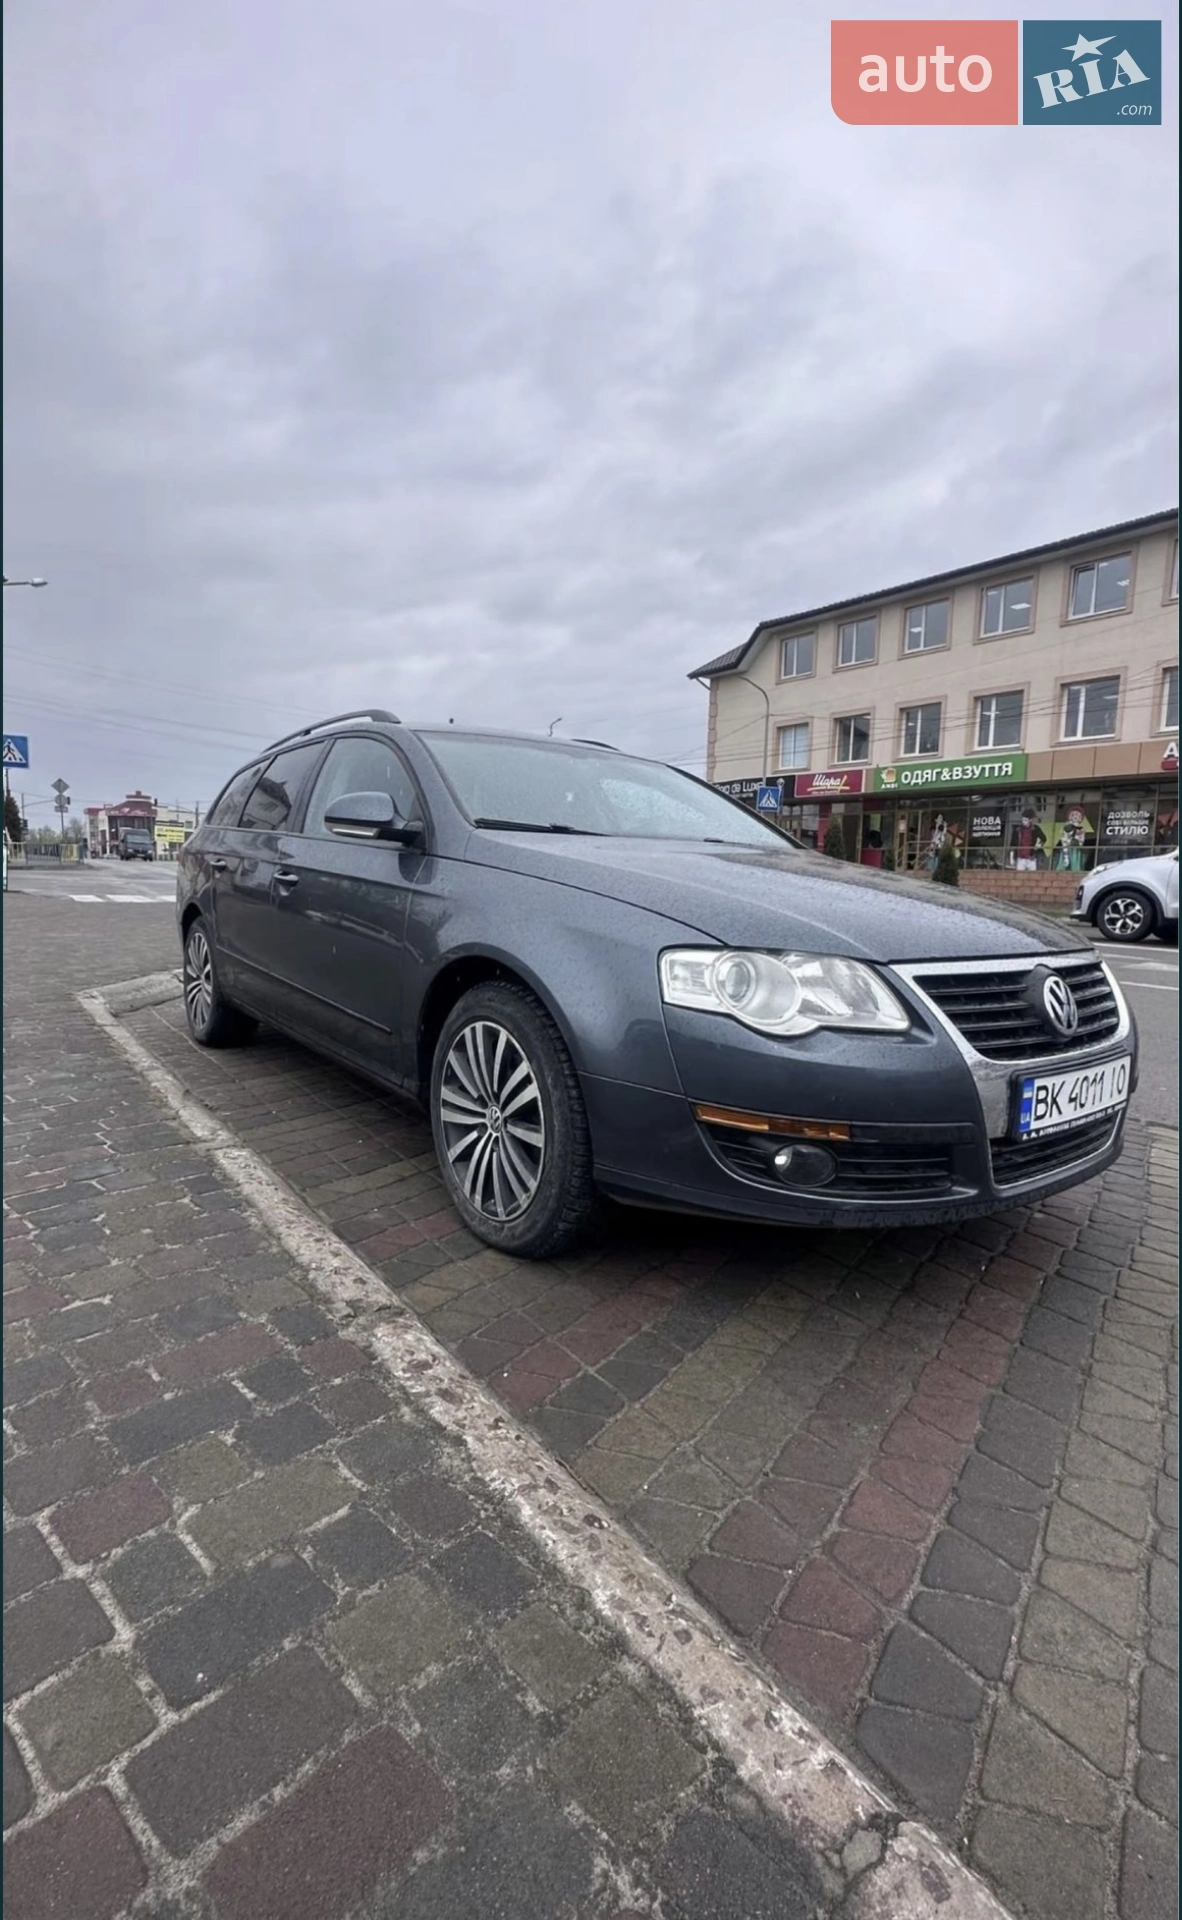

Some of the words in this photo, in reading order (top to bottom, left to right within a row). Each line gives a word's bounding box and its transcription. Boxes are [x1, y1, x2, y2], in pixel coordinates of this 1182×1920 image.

[901, 762, 1013, 786] ОДЯГ&ВЗУТТЯ
[973, 816, 1001, 826] НОВА
[1106, 826, 1149, 836] СТИЛЮ
[1034, 1080, 1066, 1121] BK
[1068, 1070, 1105, 1111] 4011
[1020, 1112, 1031, 1124] UA
